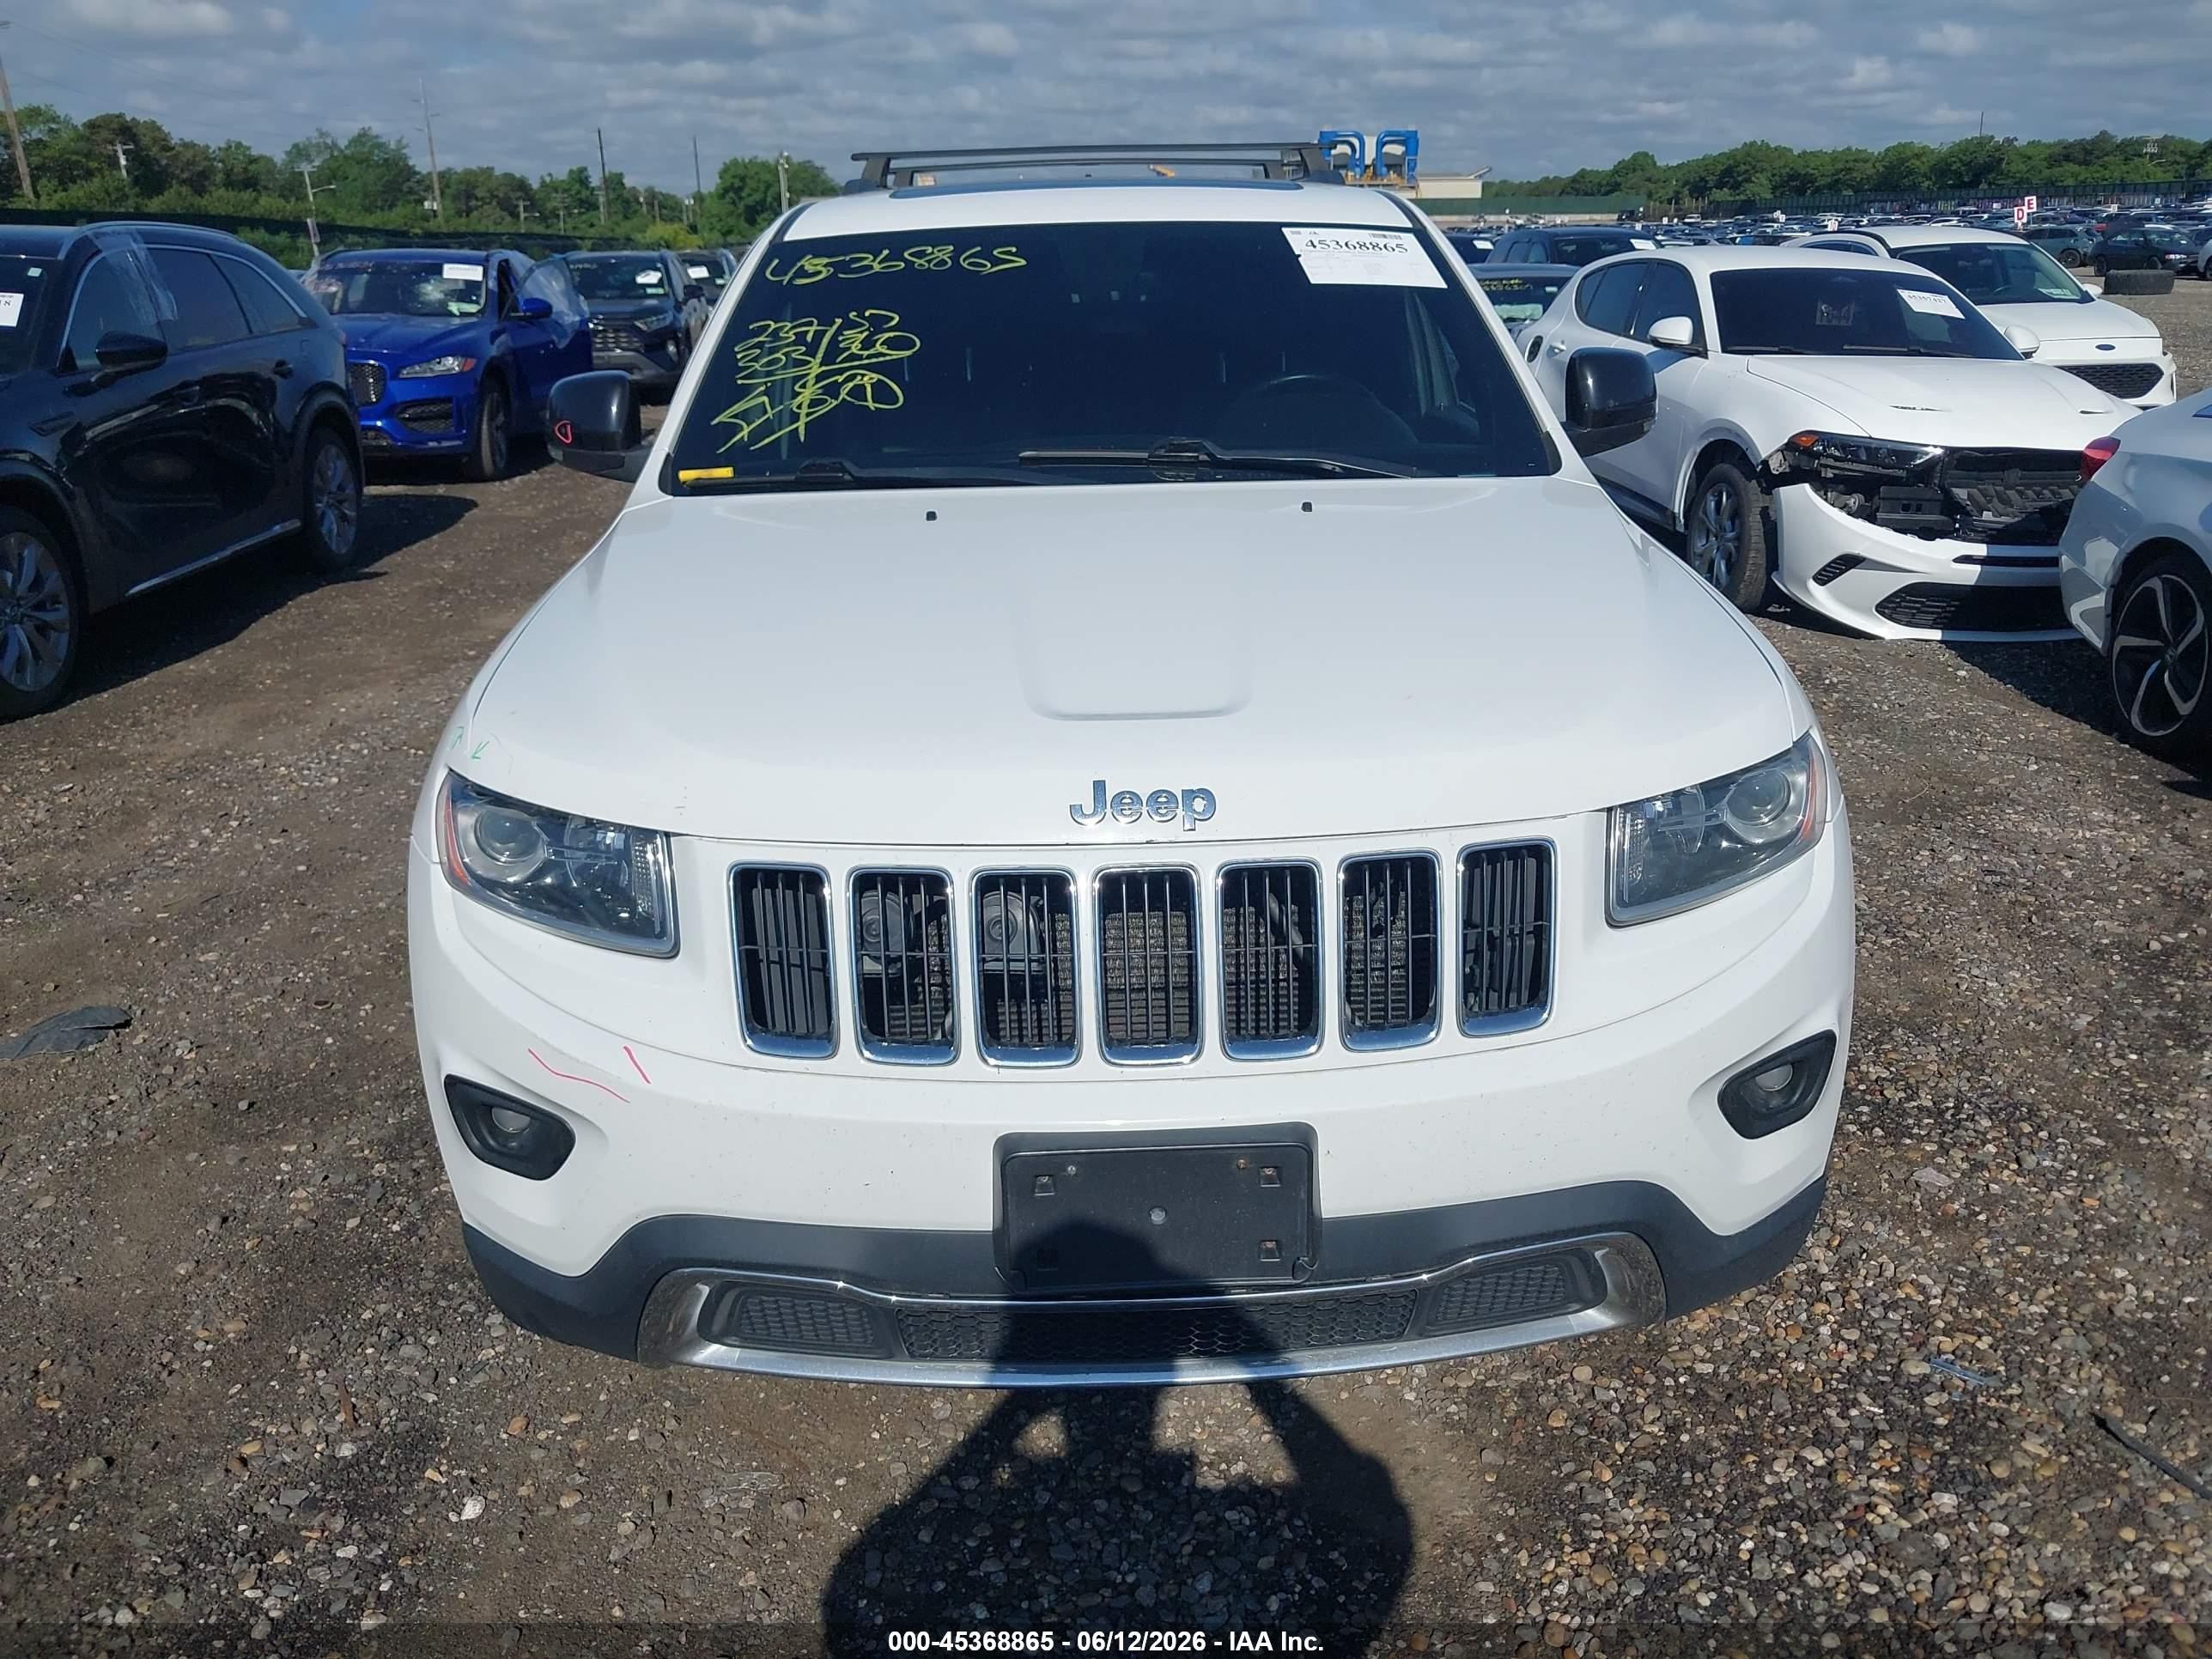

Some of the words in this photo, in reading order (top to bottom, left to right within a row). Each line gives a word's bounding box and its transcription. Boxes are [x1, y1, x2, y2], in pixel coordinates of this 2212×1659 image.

[2027, 198, 2034, 210] E
[2016, 208, 2025, 221] D
[1304, 239, 1408, 254] 45368865
[1070, 779, 1217, 832] Jeep
